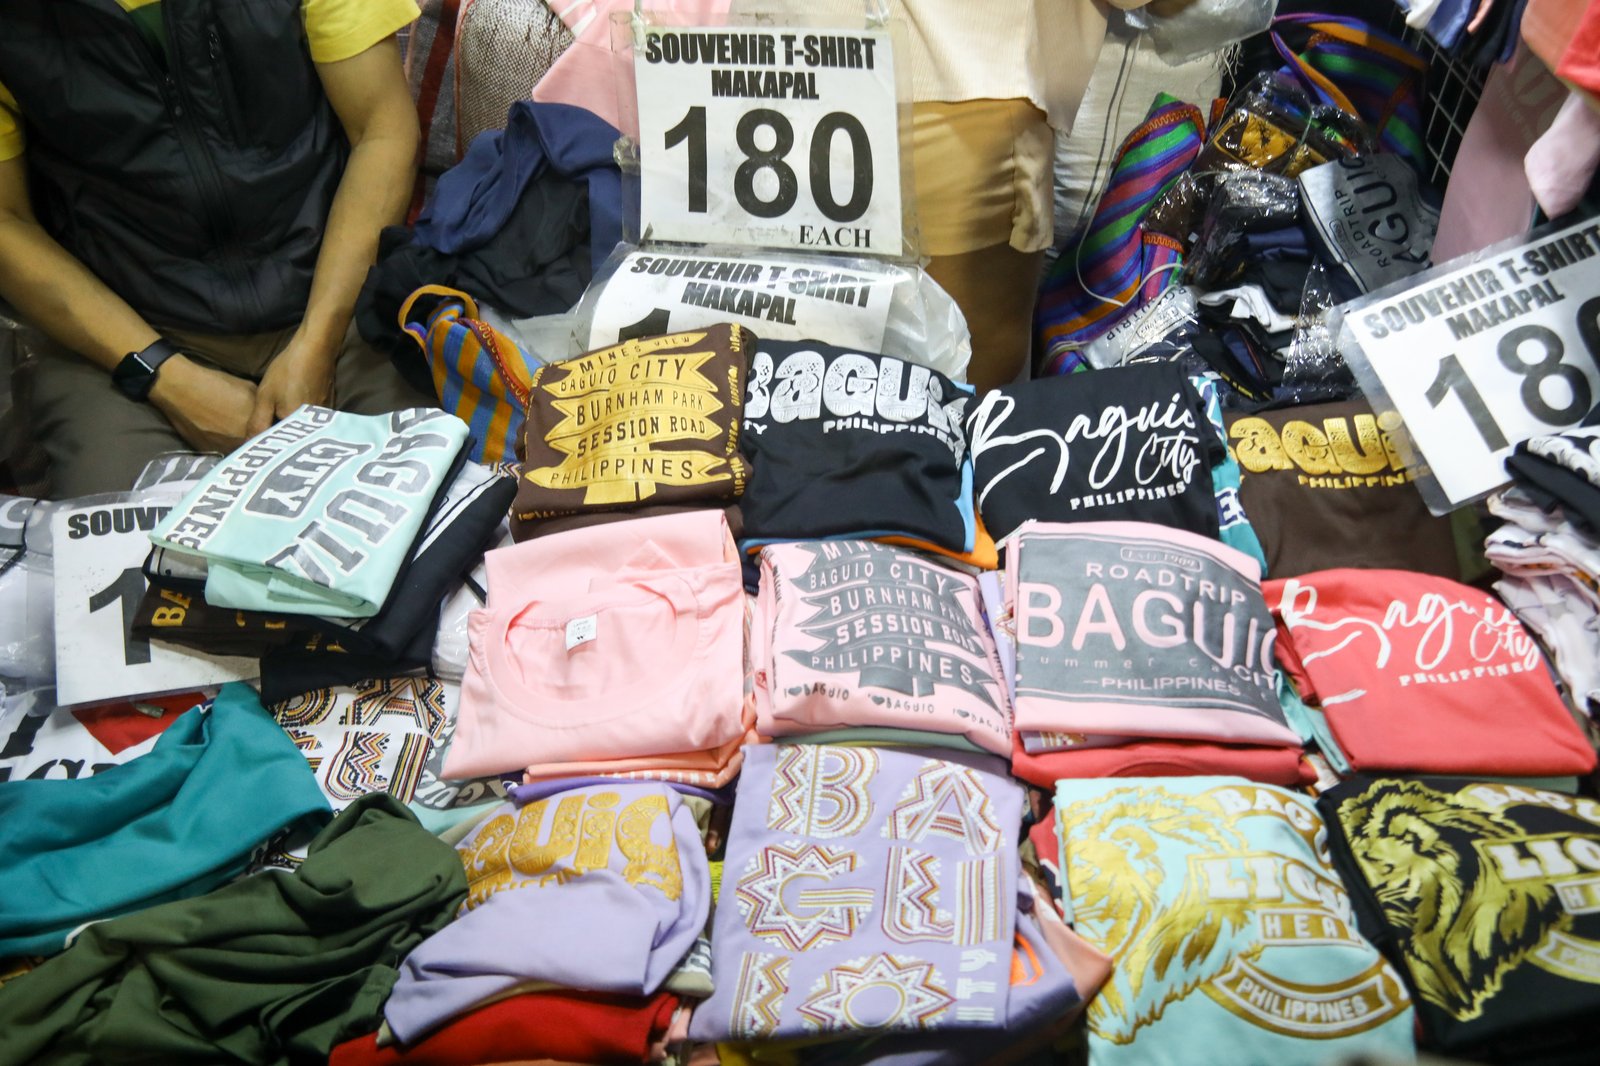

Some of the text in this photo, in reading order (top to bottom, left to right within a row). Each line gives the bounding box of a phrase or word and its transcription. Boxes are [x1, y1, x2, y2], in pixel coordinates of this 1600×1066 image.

[645, 33, 876, 70] SOUVENIR T-SHIRT
[711, 70, 820, 100] MAKAPAL
[664, 105, 874, 223] 180
[1338, 157, 1434, 270] AGUI
[799, 225, 872, 249] EACH
[630, 256, 873, 308] SOUVENIR T-SHIRT
[1363, 224, 1600, 340] SOUVENIR T-SHIRT
[680, 281, 797, 326] MAKAPAL
[1445, 279, 1566, 342] MAKAPAL
[560, 367, 617, 392] BAGUIO
[630, 358, 686, 381] CITY
[580, 346, 642, 375] MINES
[577, 389, 704, 426] BURNHAM PARK
[577, 416, 706, 459] SESSION ROAD
[550, 457, 693, 485] PHILIPPINES
[1135, 430, 1201, 485] City
[260, 441, 359, 513] CITY
[1070, 481, 1187, 511] PHILIPPINES
[810, 562, 947, 596] BAGUIO CITY
[1086, 562, 1246, 606] ROADTRIP
[830, 587, 933, 617] BURNHAM
[836, 614, 976, 653] SESSION ROAD
[812, 647, 973, 685] PHILIPPINES
[1233, 664, 1276, 690] CIT
[1400, 661, 1524, 687] PHILIPPINE
[1101, 676, 1241, 696] PHILIPPINES
[886, 696, 935, 714] BAGUIO
[1488, 837, 1600, 881] LIO
[1236, 977, 1369, 1022] PHILIPPINES
